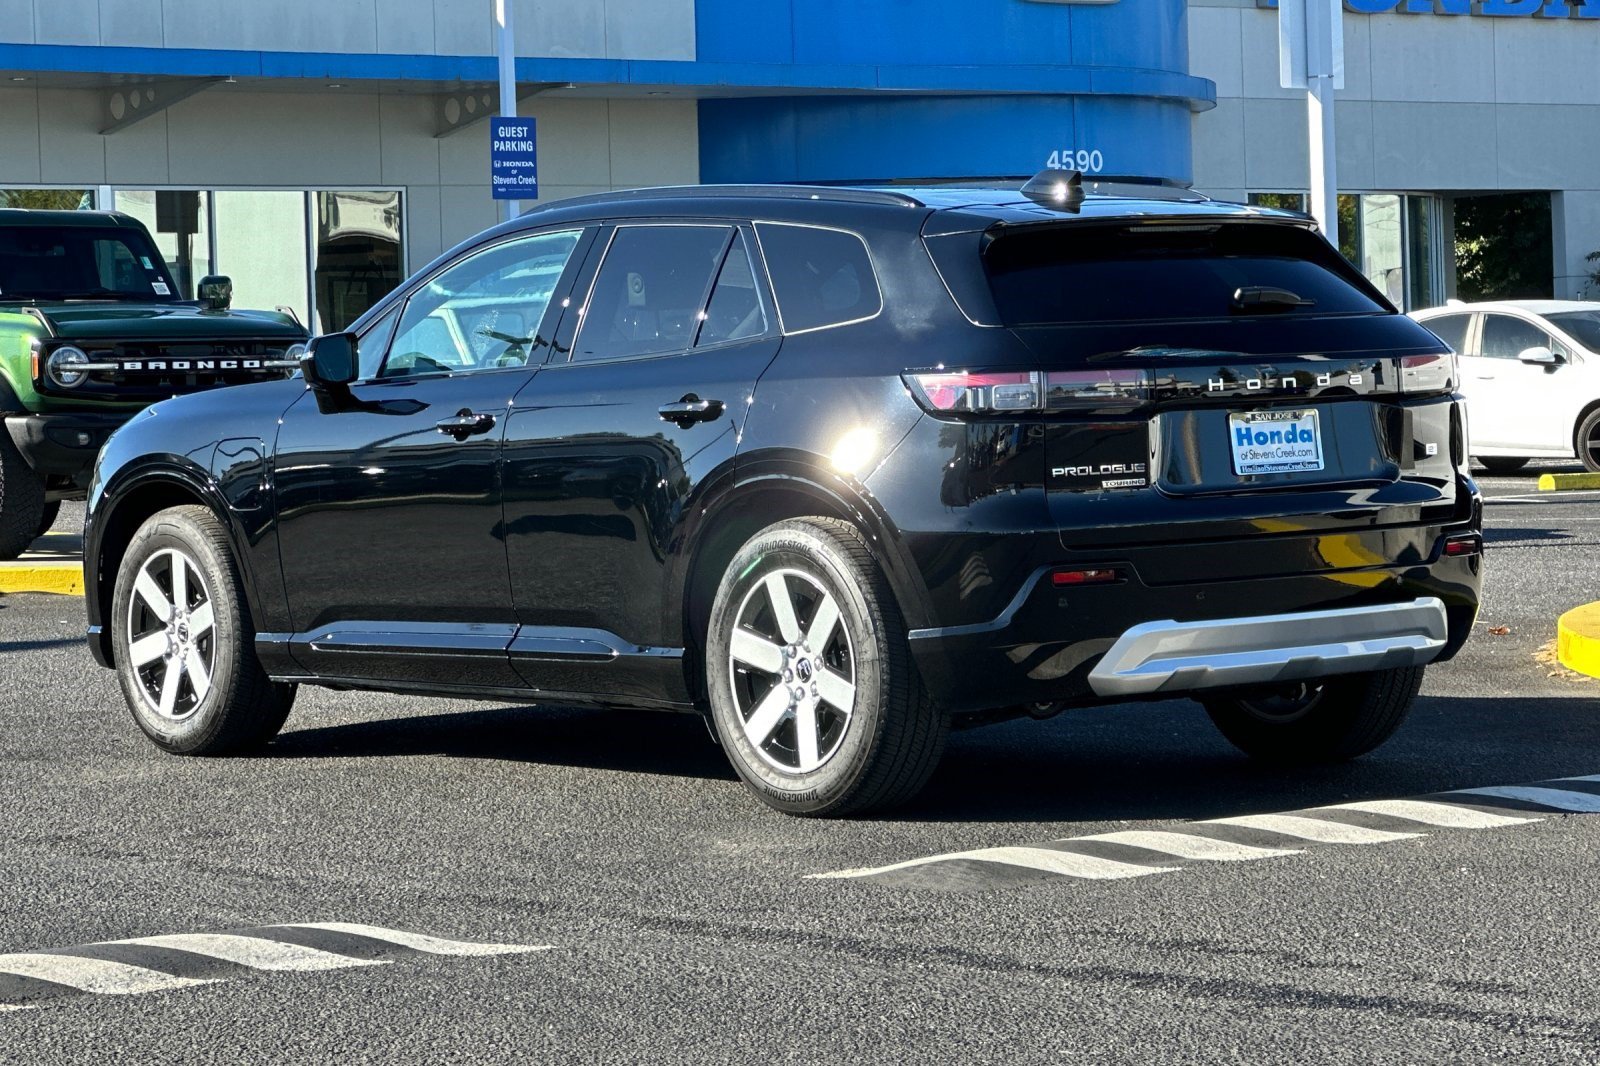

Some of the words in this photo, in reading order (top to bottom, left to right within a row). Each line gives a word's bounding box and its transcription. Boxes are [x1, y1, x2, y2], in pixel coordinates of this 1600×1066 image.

[498, 126, 528, 137] GUEST
[494, 141, 533, 151] PARKING
[1046, 149, 1104, 173] 4590
[493, 175, 517, 184] Stevens
[518, 175, 536, 184] Creek
[123, 360, 261, 370] BRONCO
[1208, 372, 1363, 392] Honda
[1254, 413, 1272, 421] SAN
[1274, 412, 1295, 420] JOSE
[1235, 423, 1313, 447] Honda
[1240, 451, 1249, 461] of
[1249, 449, 1275, 460] Stevens
[1275, 446, 1313, 459] Creek.com
[1052, 463, 1146, 477] PROLOGUE
[1103, 479, 1145, 488] TOURING
[757, 539, 813, 557] BRIDGESTONE
[763, 784, 819, 803] BRIDGESTONE
